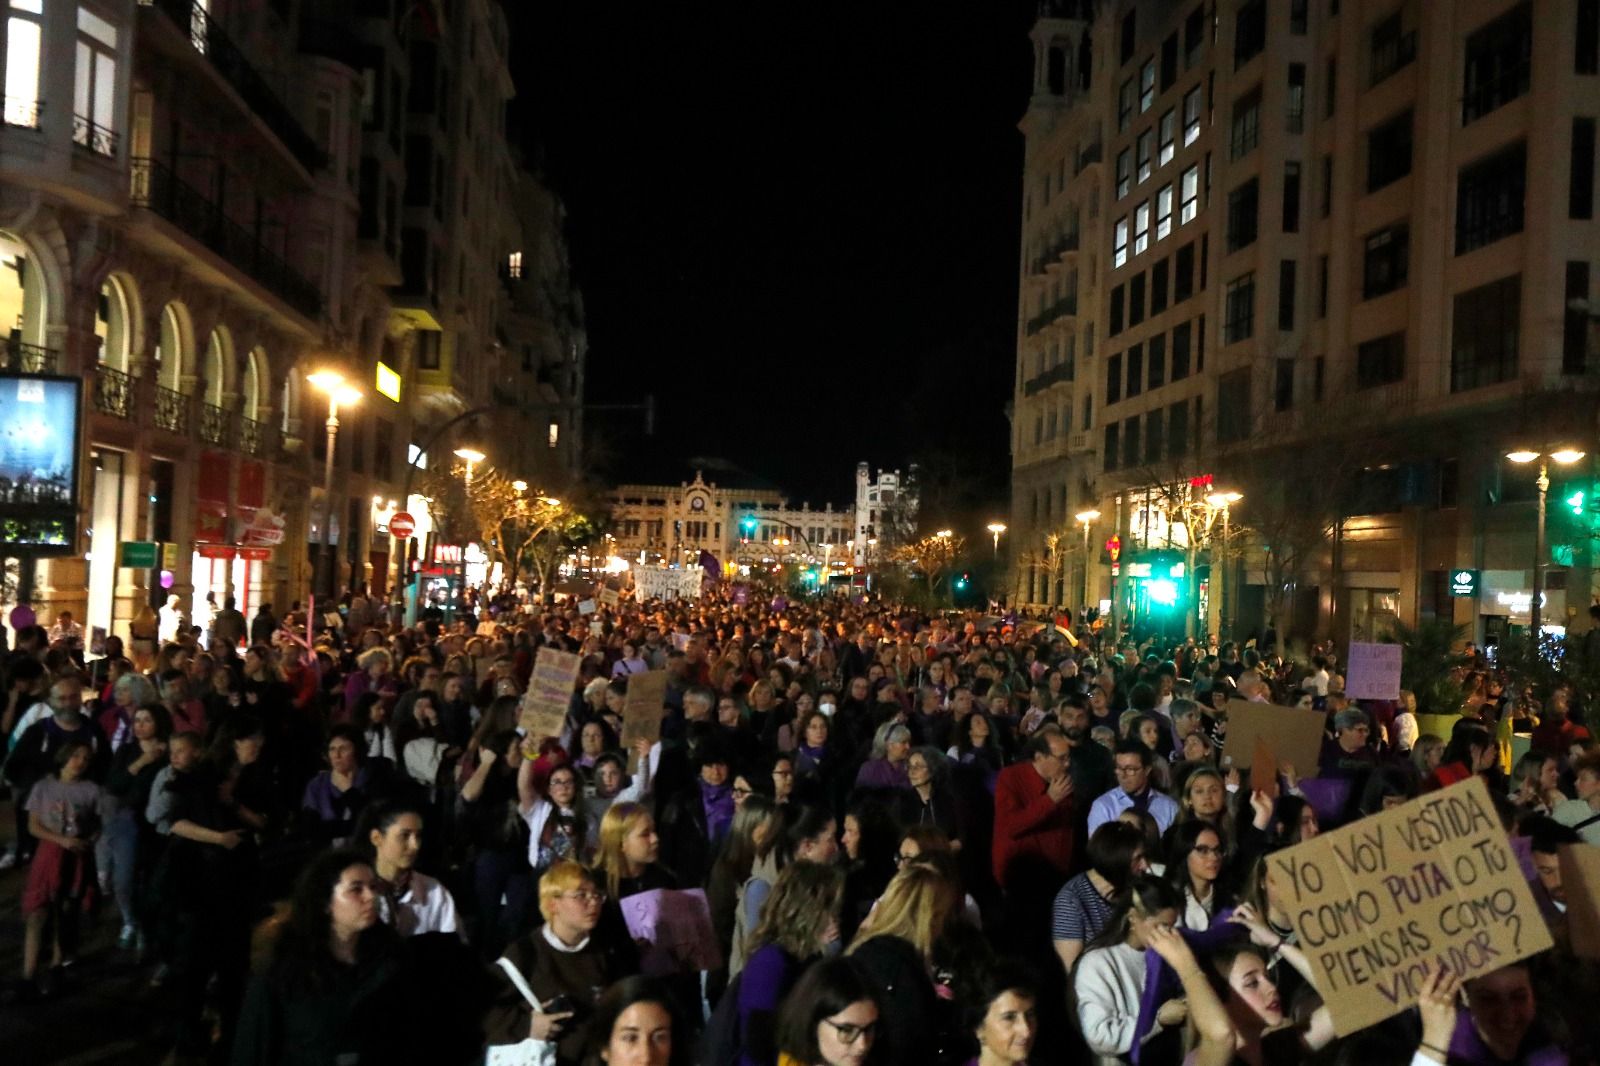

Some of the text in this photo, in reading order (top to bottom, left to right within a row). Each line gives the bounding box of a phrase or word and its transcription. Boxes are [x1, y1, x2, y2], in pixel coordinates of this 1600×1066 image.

[1276, 790, 1494, 902] YO VOY VESTIDA
[1298, 838, 1508, 948] COMO PUTA O TÚ
[1320, 888, 1516, 993] PIENSAS COMO
[1376, 931, 1500, 1004] VIOADOR
